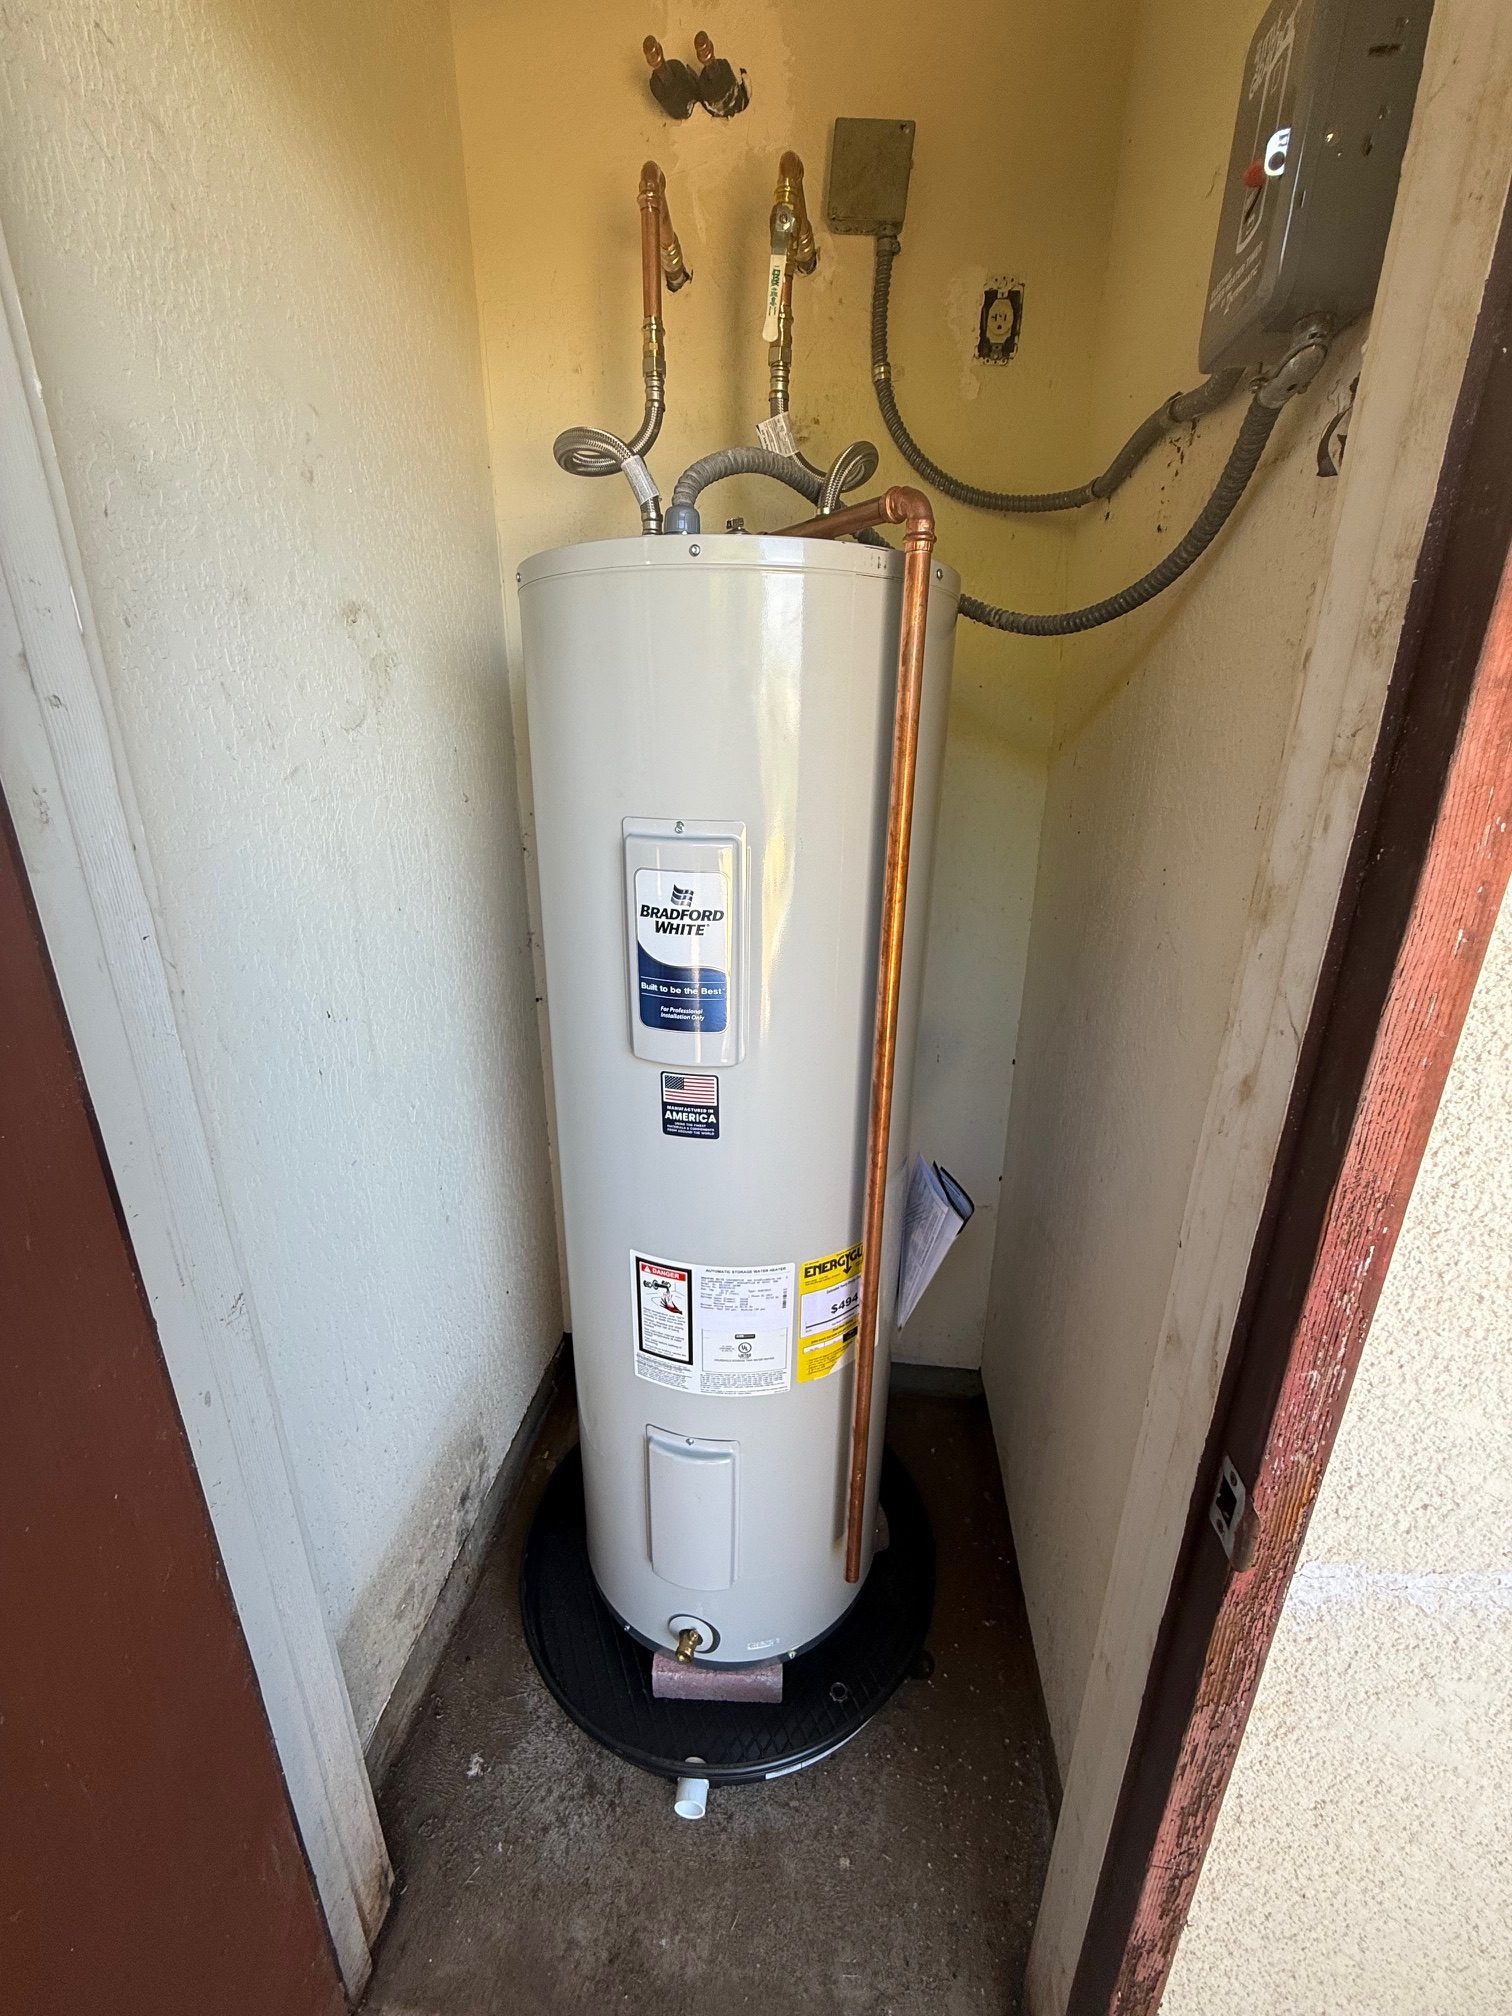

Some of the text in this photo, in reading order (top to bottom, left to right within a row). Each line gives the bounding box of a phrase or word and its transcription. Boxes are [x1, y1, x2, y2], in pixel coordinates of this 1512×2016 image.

[640, 904, 725, 922] BRADFORD
[655, 920, 706, 936] WHITE
[641, 981, 722, 995] Built to be the Best
[669, 1006, 703, 1015] Professional
[667, 1105, 707, 1113] MANUFACTURED
[665, 1110, 716, 1123] AMERICA
[652, 1268, 680, 1279] DANGER
